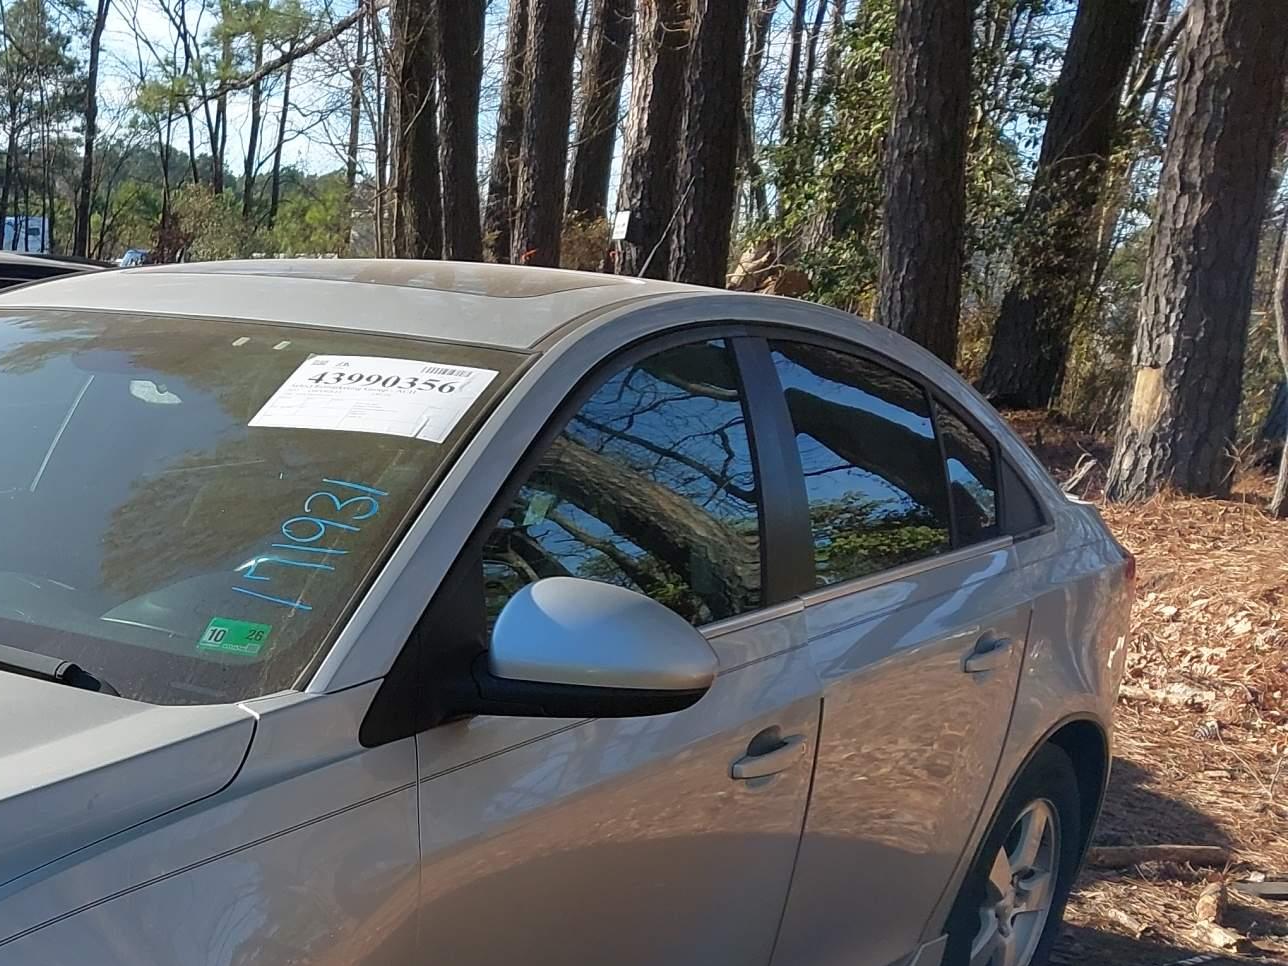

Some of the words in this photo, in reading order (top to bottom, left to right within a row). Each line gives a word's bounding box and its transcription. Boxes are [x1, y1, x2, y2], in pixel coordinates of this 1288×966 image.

[308, 370, 456, 394] 43990356
[207, 627, 227, 643] 10
[246, 629, 265, 642] 26
